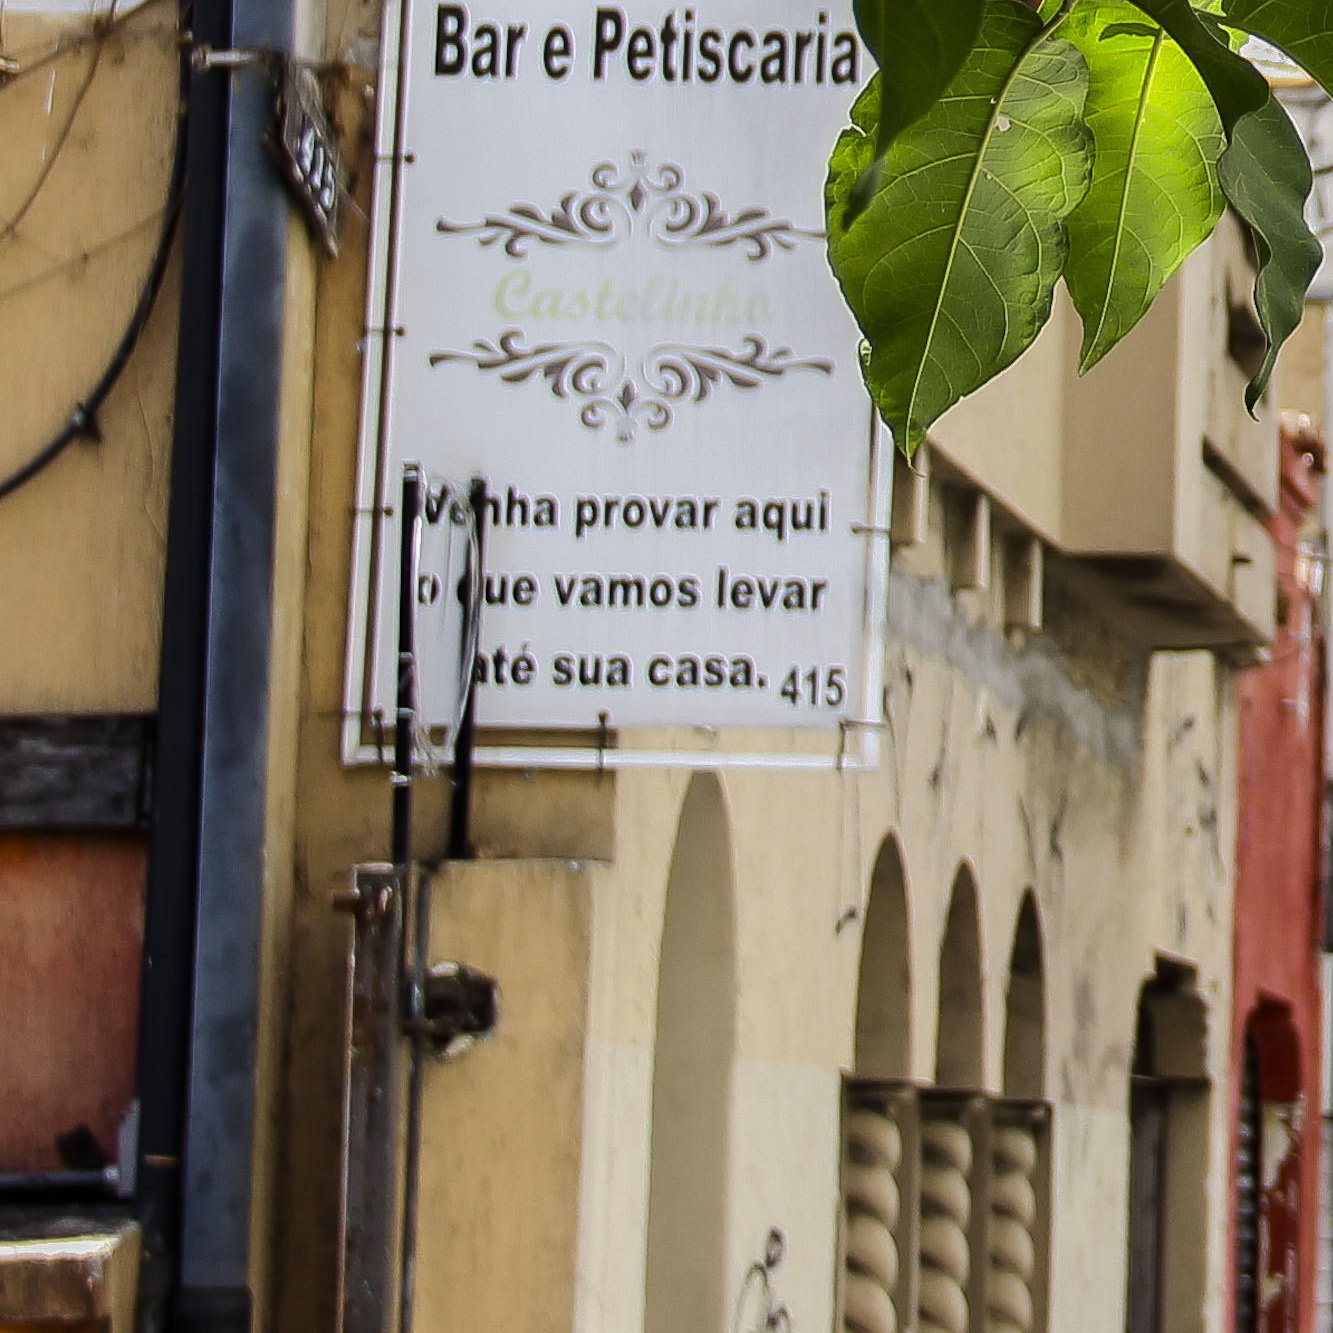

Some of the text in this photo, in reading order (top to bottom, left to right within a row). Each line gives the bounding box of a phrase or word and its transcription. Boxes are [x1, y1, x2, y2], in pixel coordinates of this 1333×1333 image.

[434, 3, 858, 86] Bar e Petiscaria
[575, 494, 719, 539] provar
[734, 491, 831, 542] aqui
[554, 574, 698, 607] vamos
[717, 567, 827, 610] levar
[552, 652, 630, 687] sua
[648, 653, 766, 688] casa.
[781, 665, 845, 707] 415
